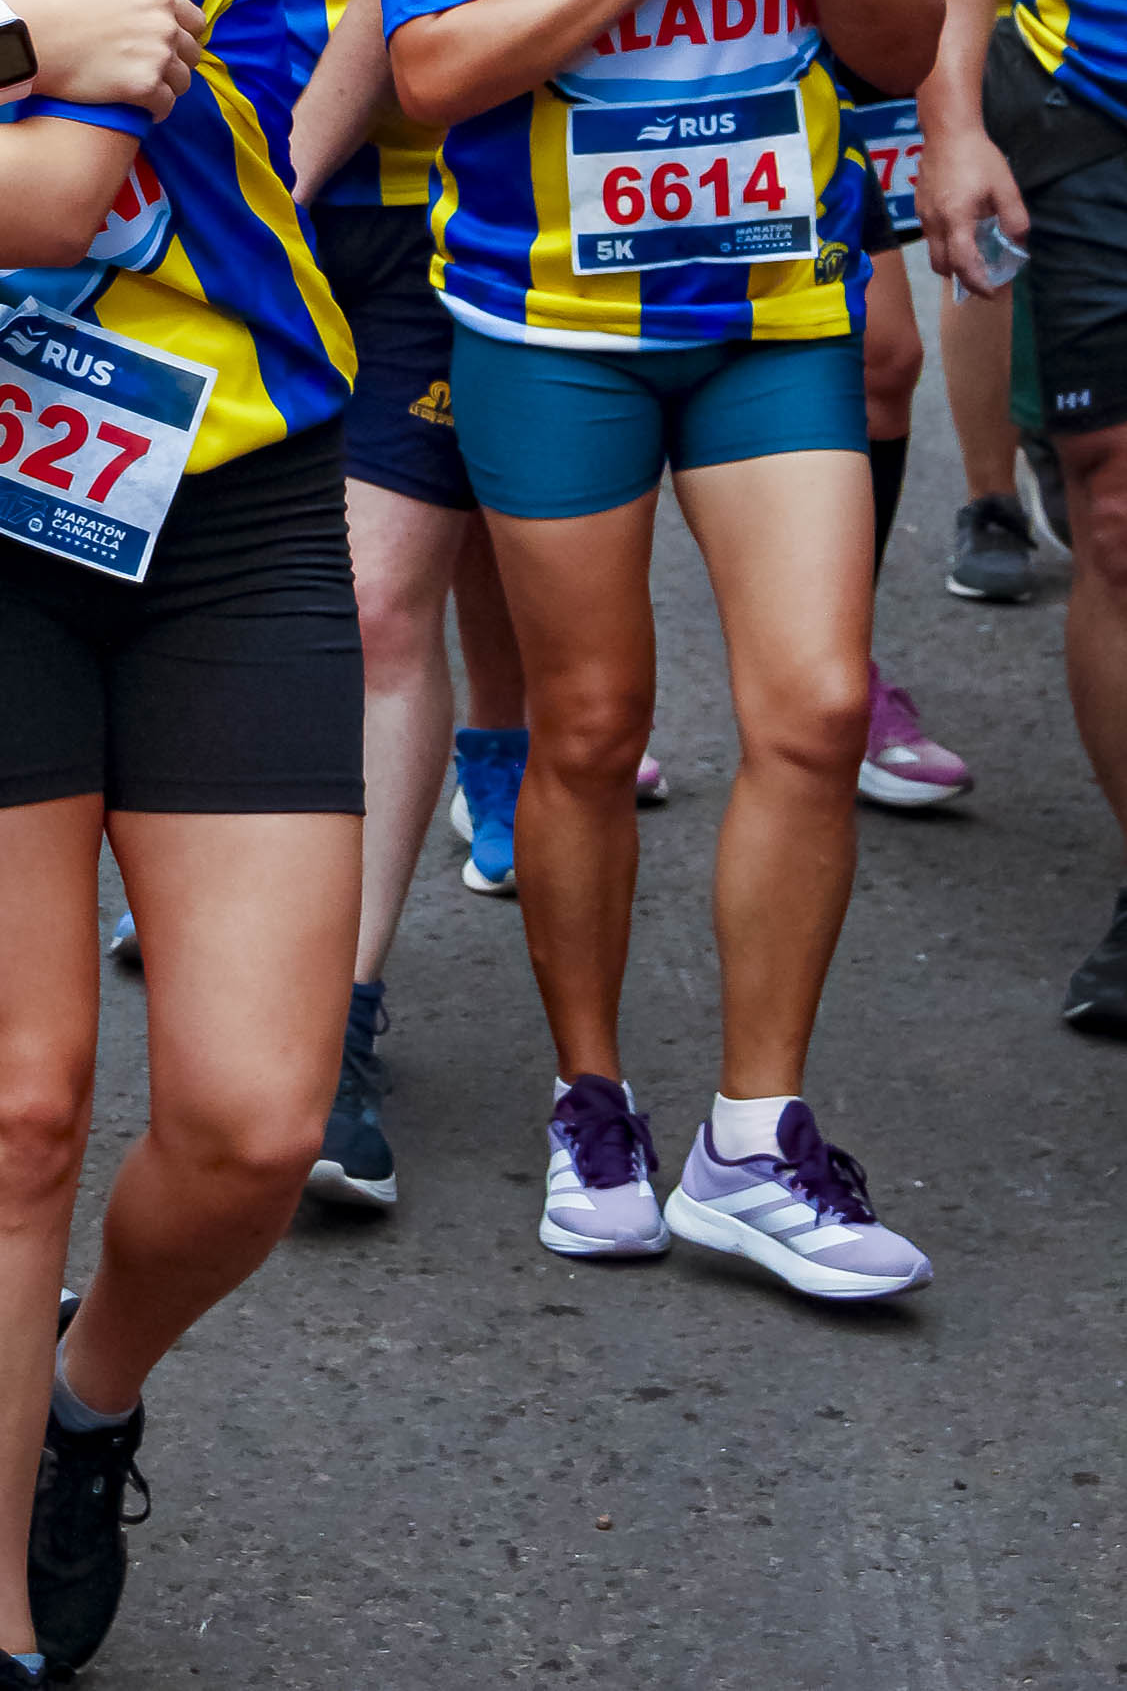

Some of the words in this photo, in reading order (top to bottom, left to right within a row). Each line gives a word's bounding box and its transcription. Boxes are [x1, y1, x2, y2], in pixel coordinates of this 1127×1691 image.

[679, 112, 737, 138] RUS
[602, 150, 787, 226] 6614
[596, 239, 635, 261] 5K
[40, 339, 116, 387] RUS
[52, 519, 120, 551] CANALLA
[53, 507, 127, 541] MARATÓN
